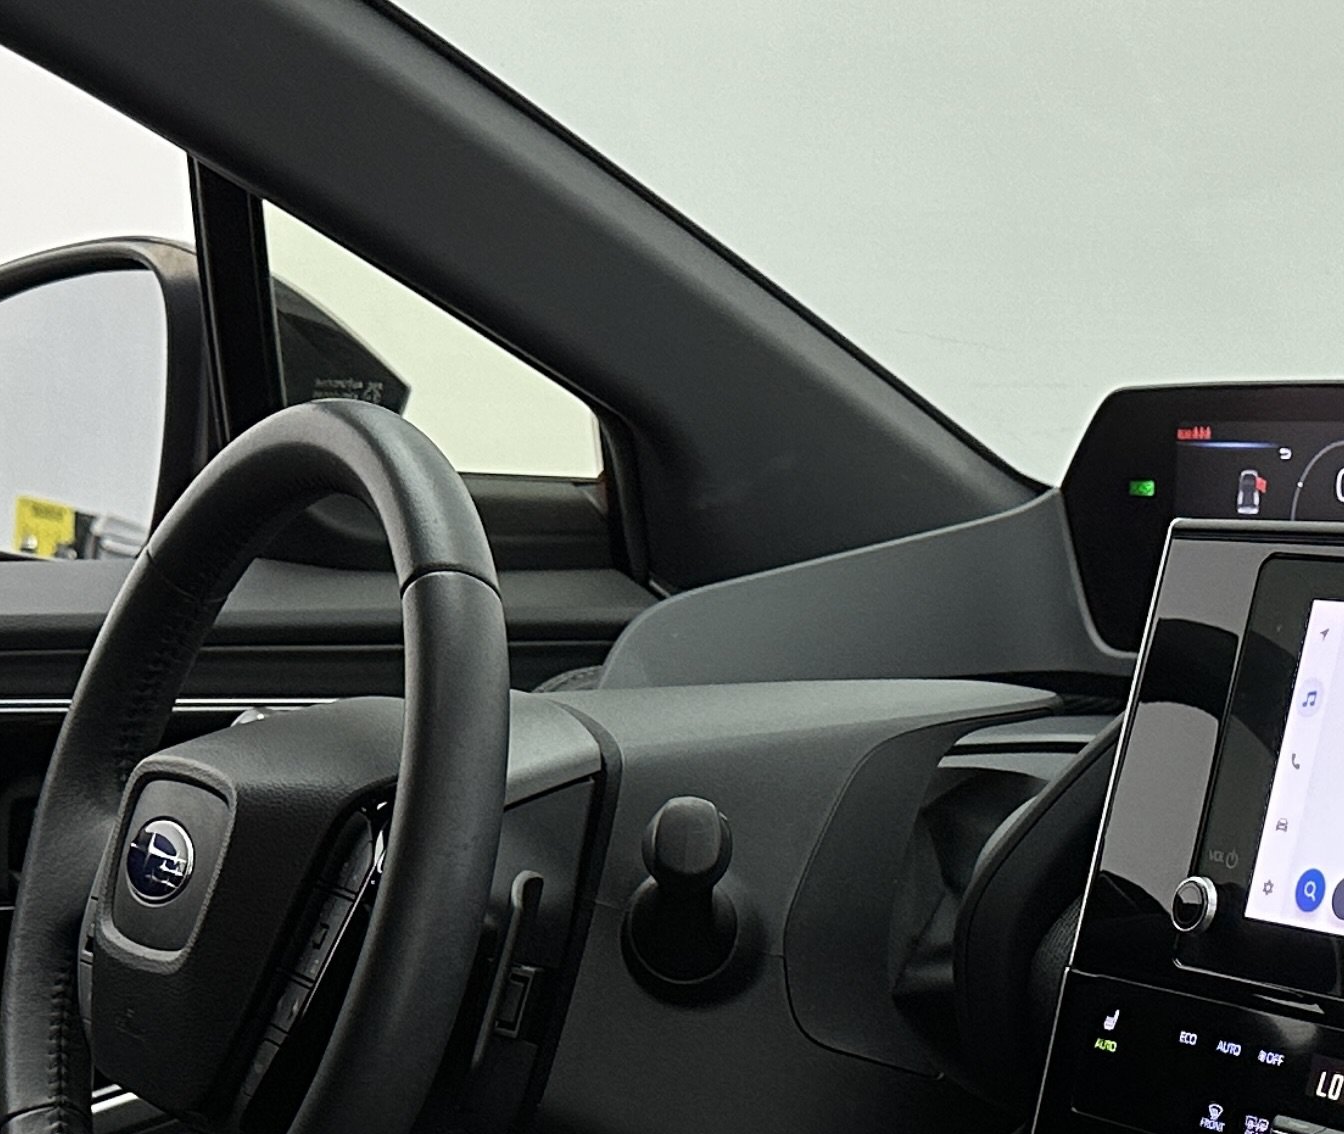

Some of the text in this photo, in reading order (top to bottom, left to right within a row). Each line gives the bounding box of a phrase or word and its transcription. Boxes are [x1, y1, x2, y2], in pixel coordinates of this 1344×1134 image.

[1094, 1037, 1118, 1053] AUTO
[1179, 1031, 1198, 1046] ECO
[1216, 1040, 1242, 1057] AUTO
[1266, 1053, 1285, 1067] OFF
[1199, 1116, 1226, 1133] FRONT
